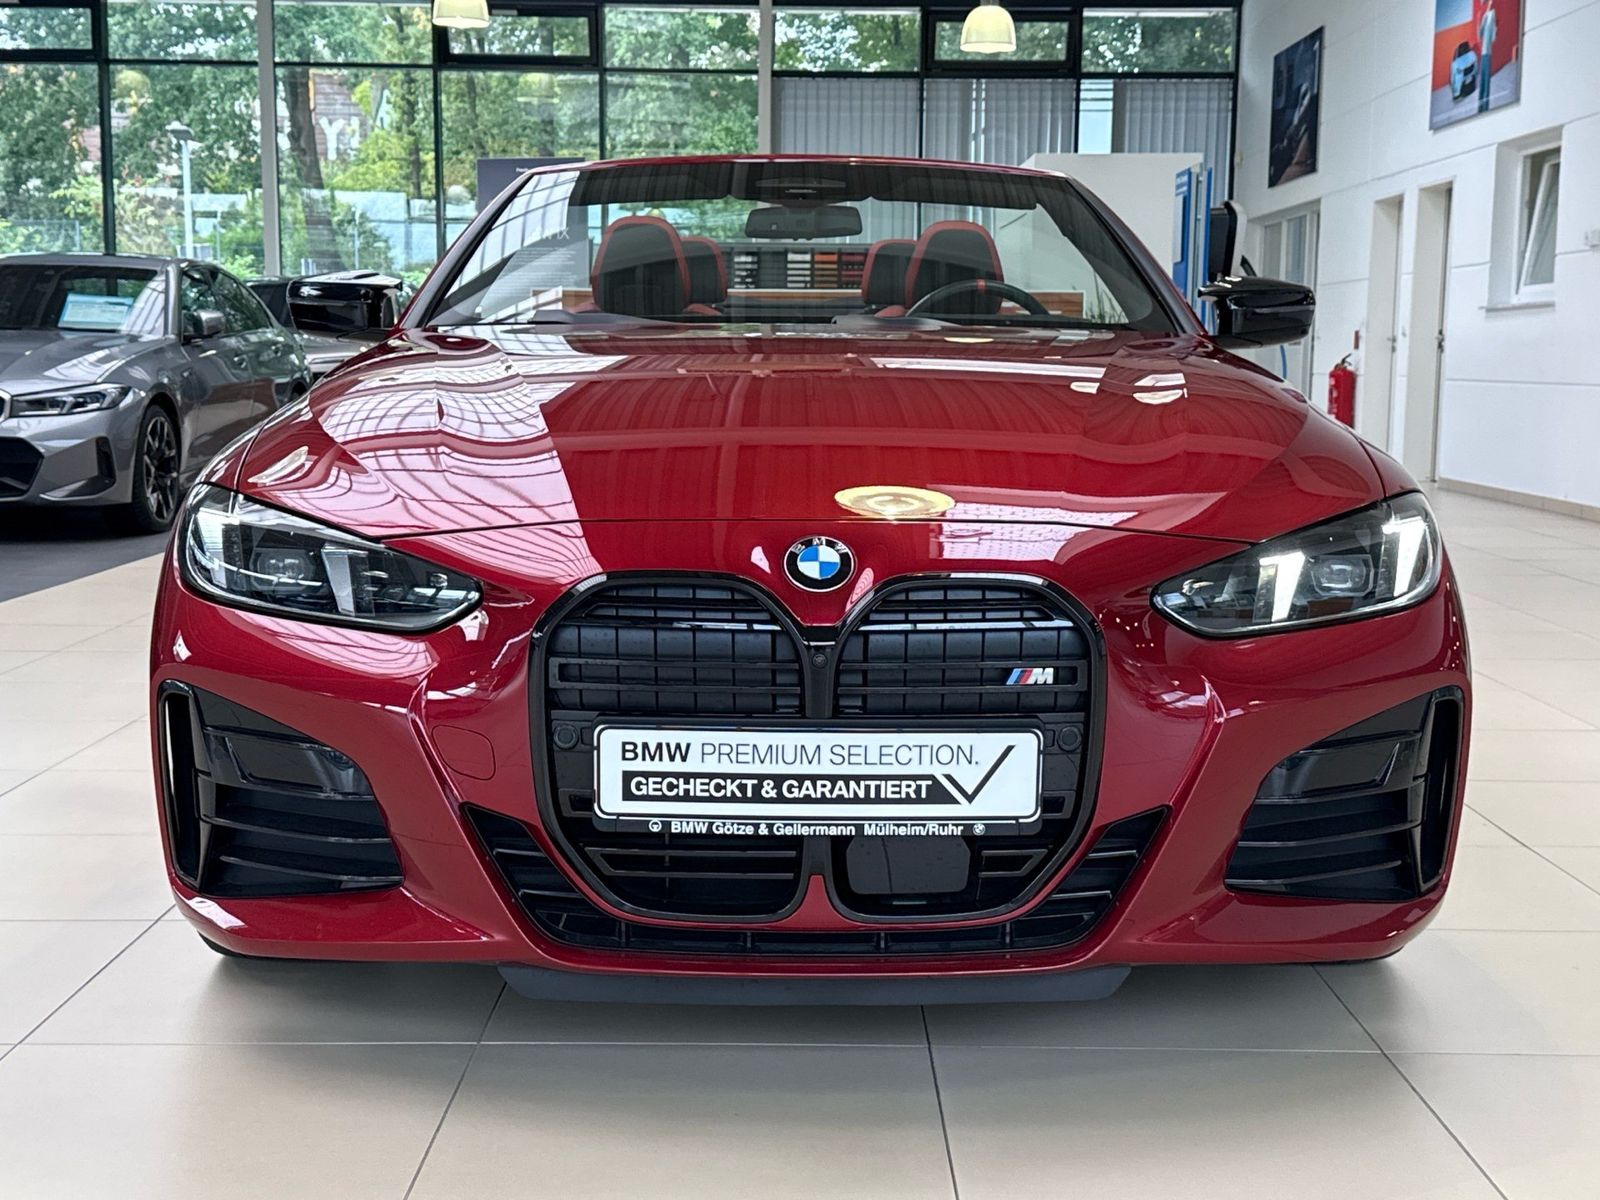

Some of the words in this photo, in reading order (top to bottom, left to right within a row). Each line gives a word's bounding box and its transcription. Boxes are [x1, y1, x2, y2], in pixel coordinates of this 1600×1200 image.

[791, 537, 848, 554] BMW
[1026, 667, 1054, 685] M
[621, 741, 691, 762] BMW
[701, 743, 821, 765] PREMIUM
[830, 744, 980, 766] SELECTION.
[630, 776, 758, 798] GECHECKT
[760, 779, 777, 798] &
[782, 780, 932, 799] GARANTIERT
[671, 821, 708, 834] BMW
[713, 821, 754, 836] Götze
[758, 822, 769, 836] &
[772, 822, 856, 836] Gellermann
[863, 822, 964, 836] Mülheim/Ruhr
